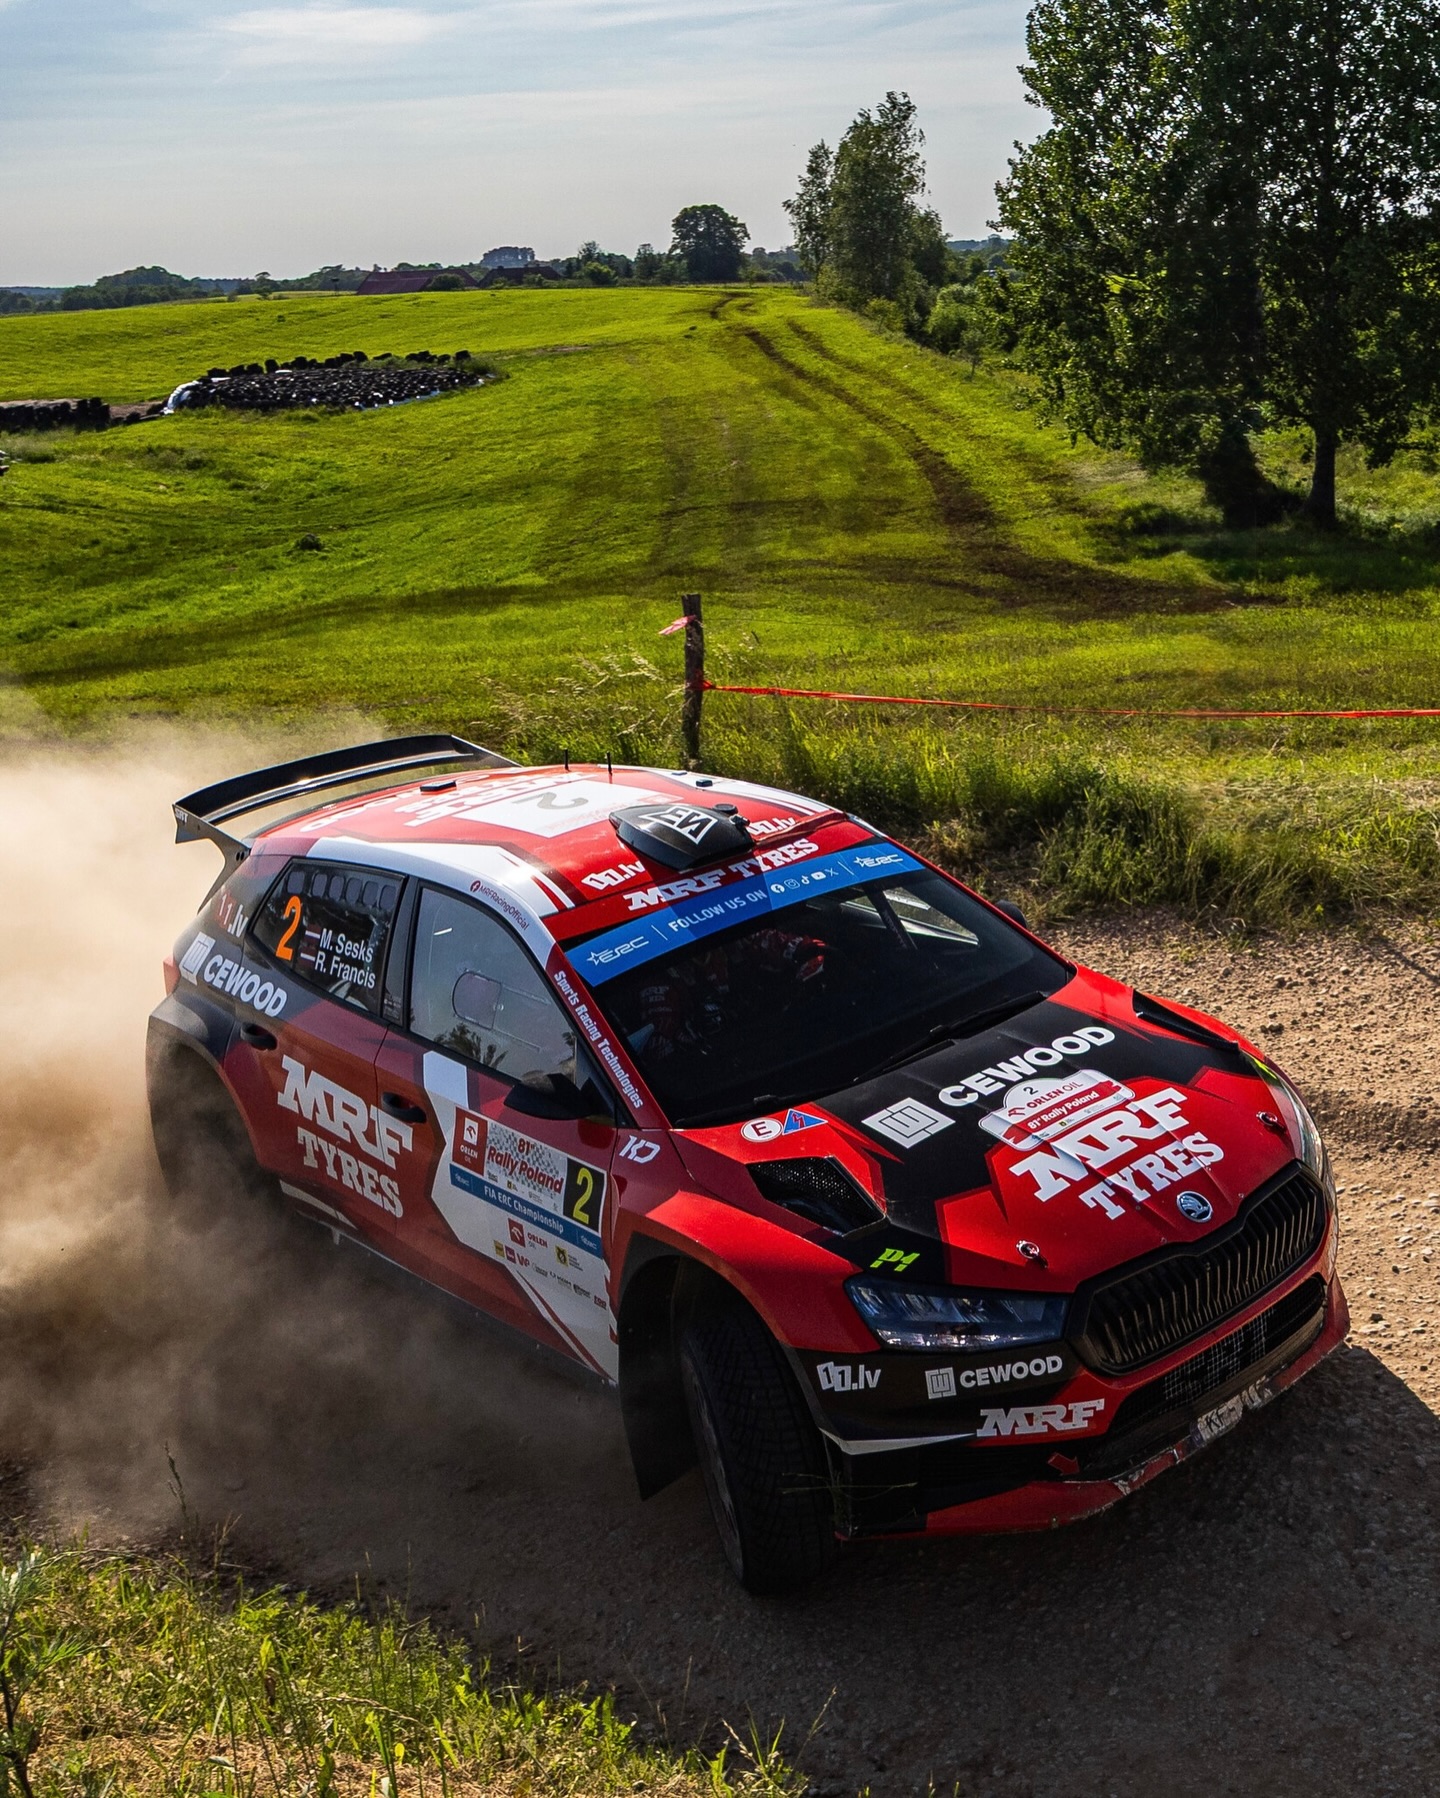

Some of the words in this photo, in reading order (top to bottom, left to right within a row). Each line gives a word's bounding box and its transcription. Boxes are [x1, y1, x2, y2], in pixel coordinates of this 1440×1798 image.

[622, 867, 727, 911] MRF
[728, 837, 820, 879] TYRES
[275, 895, 302, 961] 2
[668, 904, 726, 933] FOLLOW
[728, 896, 747, 910] US
[745, 889, 768, 903] ON
[314, 950, 327, 974] R.
[329, 955, 377, 990] Francis
[319, 927, 333, 951] M.
[335, 932, 374, 964] Sesks
[203, 953, 288, 1019] CEWOOD
[553, 970, 580, 1006] Sports
[575, 1003, 602, 1042] Racing
[597, 1038, 644, 1109] Technologies
[938, 1025, 1116, 1107] CEWOOD
[1023, 1086, 1039, 1096] 2
[277, 1054, 414, 1171] MRF
[1026, 1088, 1062, 1109] ORLEN
[1061, 1081, 1084, 1093] OIL
[1041, 1104, 1068, 1123] Rally
[1066, 1091, 1100, 1110] Poland
[459, 1144, 479, 1158] ORLEN
[750, 1120, 772, 1137] E
[1008, 1086, 1190, 1202] MRF
[297, 1126, 404, 1219] TYRES
[487, 1145, 519, 1177] Rally
[518, 1167, 565, 1195] Poland
[1078, 1131, 1225, 1221] TYRES
[484, 1185, 497, 1200] FIA
[498, 1192, 512, 1208] ERC
[513, 1198, 564, 1235] Championship
[572, 1167, 594, 1225] 2
[959, 1355, 1064, 1388] CEWOOD
[976, 1398, 1105, 1437] MRF
